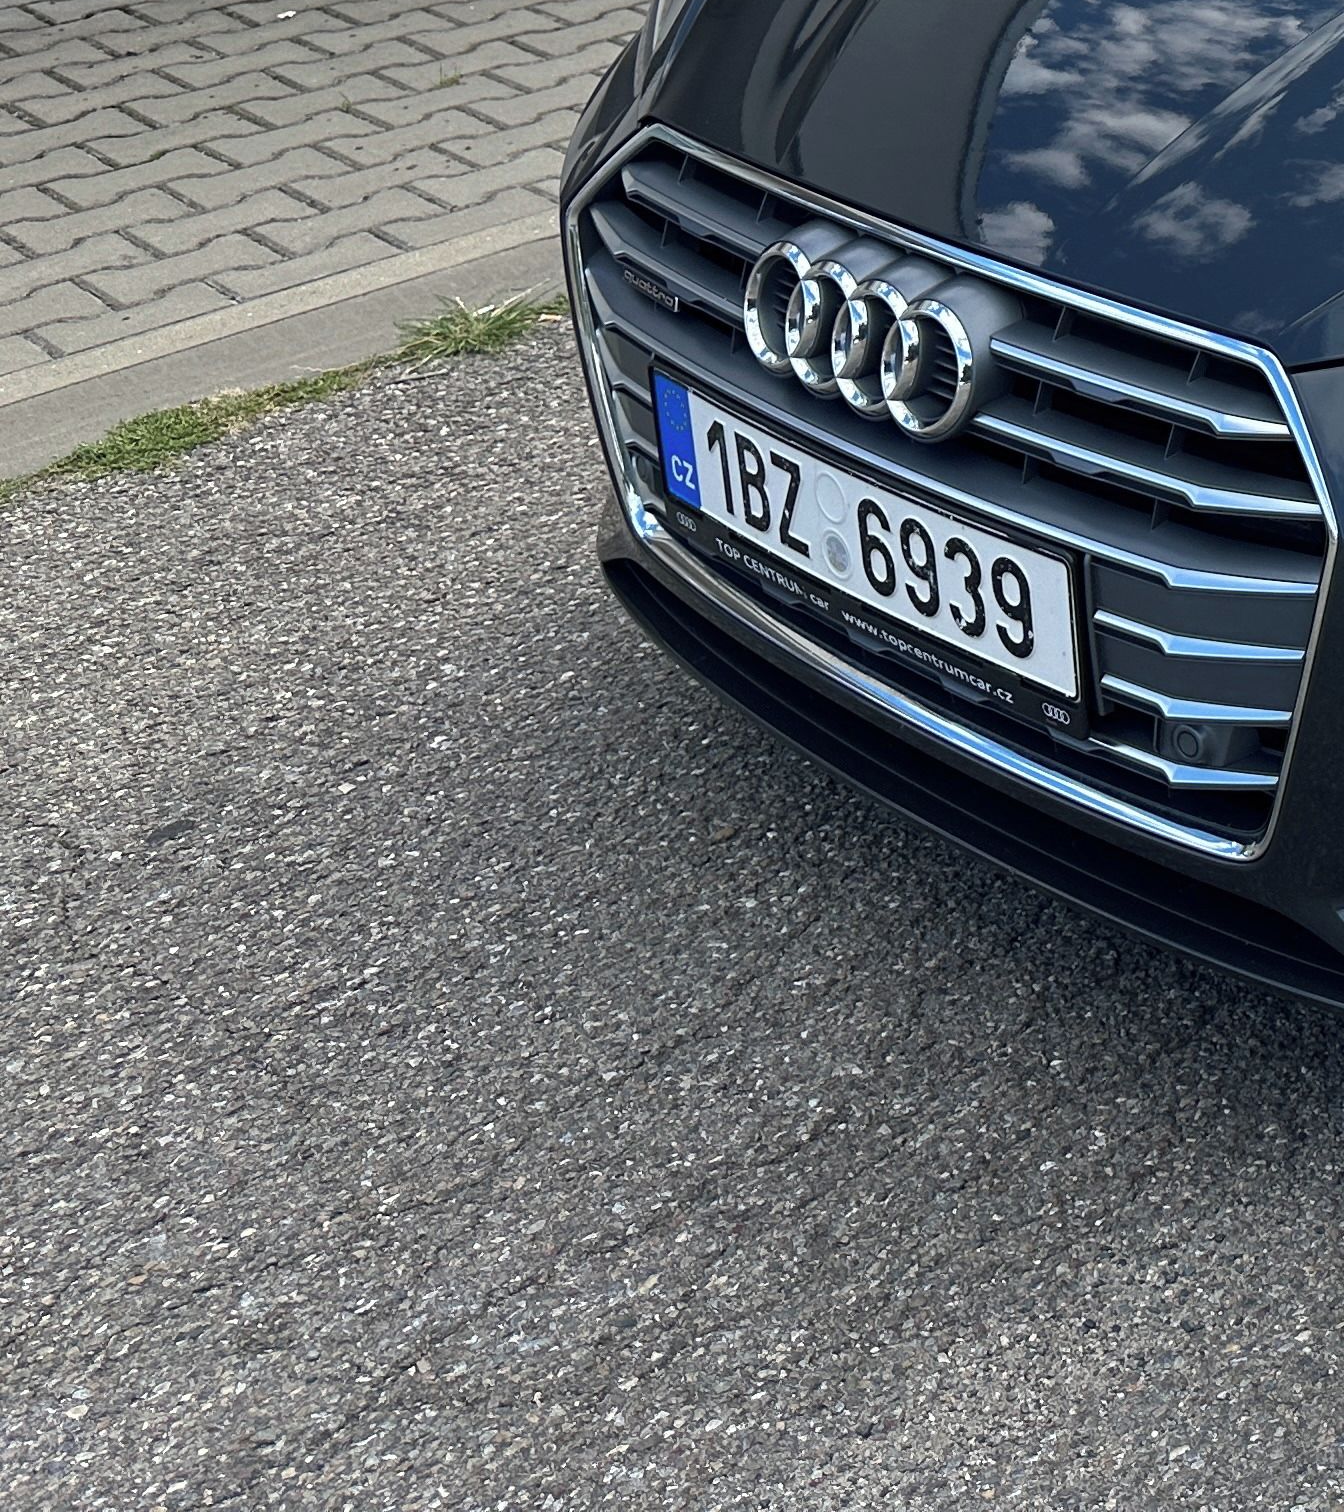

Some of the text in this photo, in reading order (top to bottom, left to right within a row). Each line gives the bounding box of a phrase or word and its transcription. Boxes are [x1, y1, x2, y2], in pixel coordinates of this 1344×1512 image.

[623, 269, 674, 307] quattro
[671, 454, 696, 490] CZ
[706, 419, 1035, 659] 1BZ 6939
[716, 538, 741, 561] TOP
[809, 593, 830, 611] car
[841, 610, 1015, 704] www.topcentrumcar.cz
